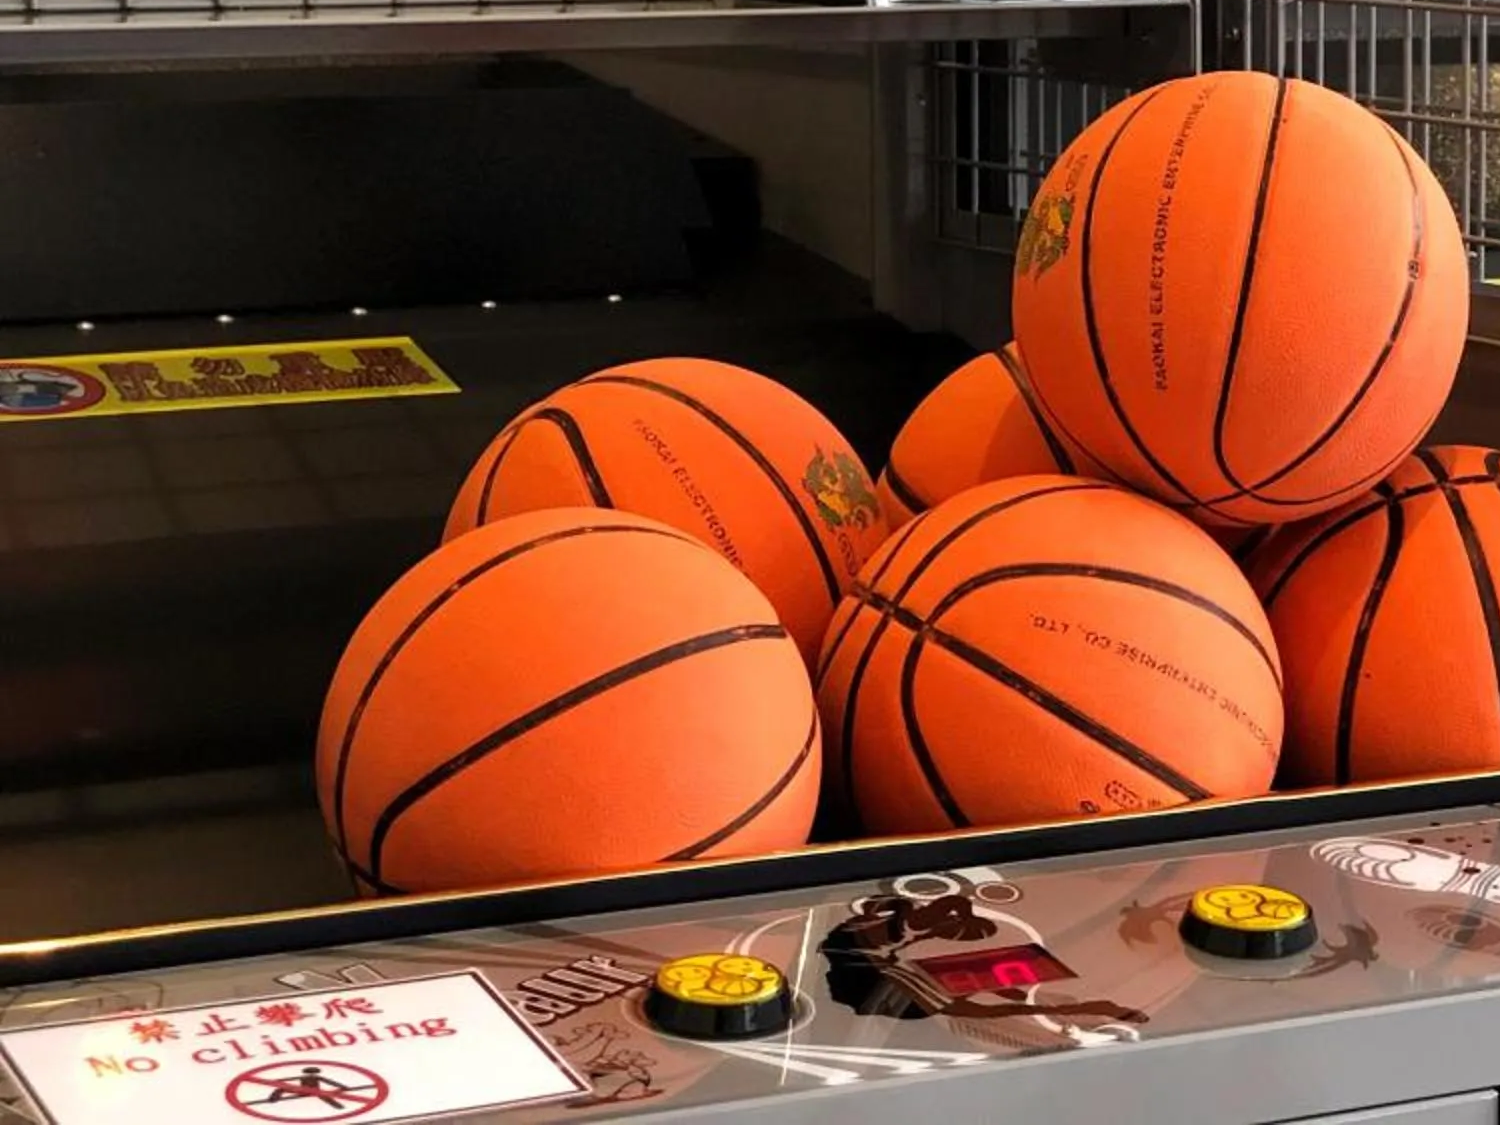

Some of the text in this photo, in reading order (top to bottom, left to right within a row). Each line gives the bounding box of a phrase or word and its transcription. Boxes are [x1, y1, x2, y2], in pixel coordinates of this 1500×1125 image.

[84, 1016, 458, 1079] No climbing
[130, 995, 385, 1045] 禁止攀爬
